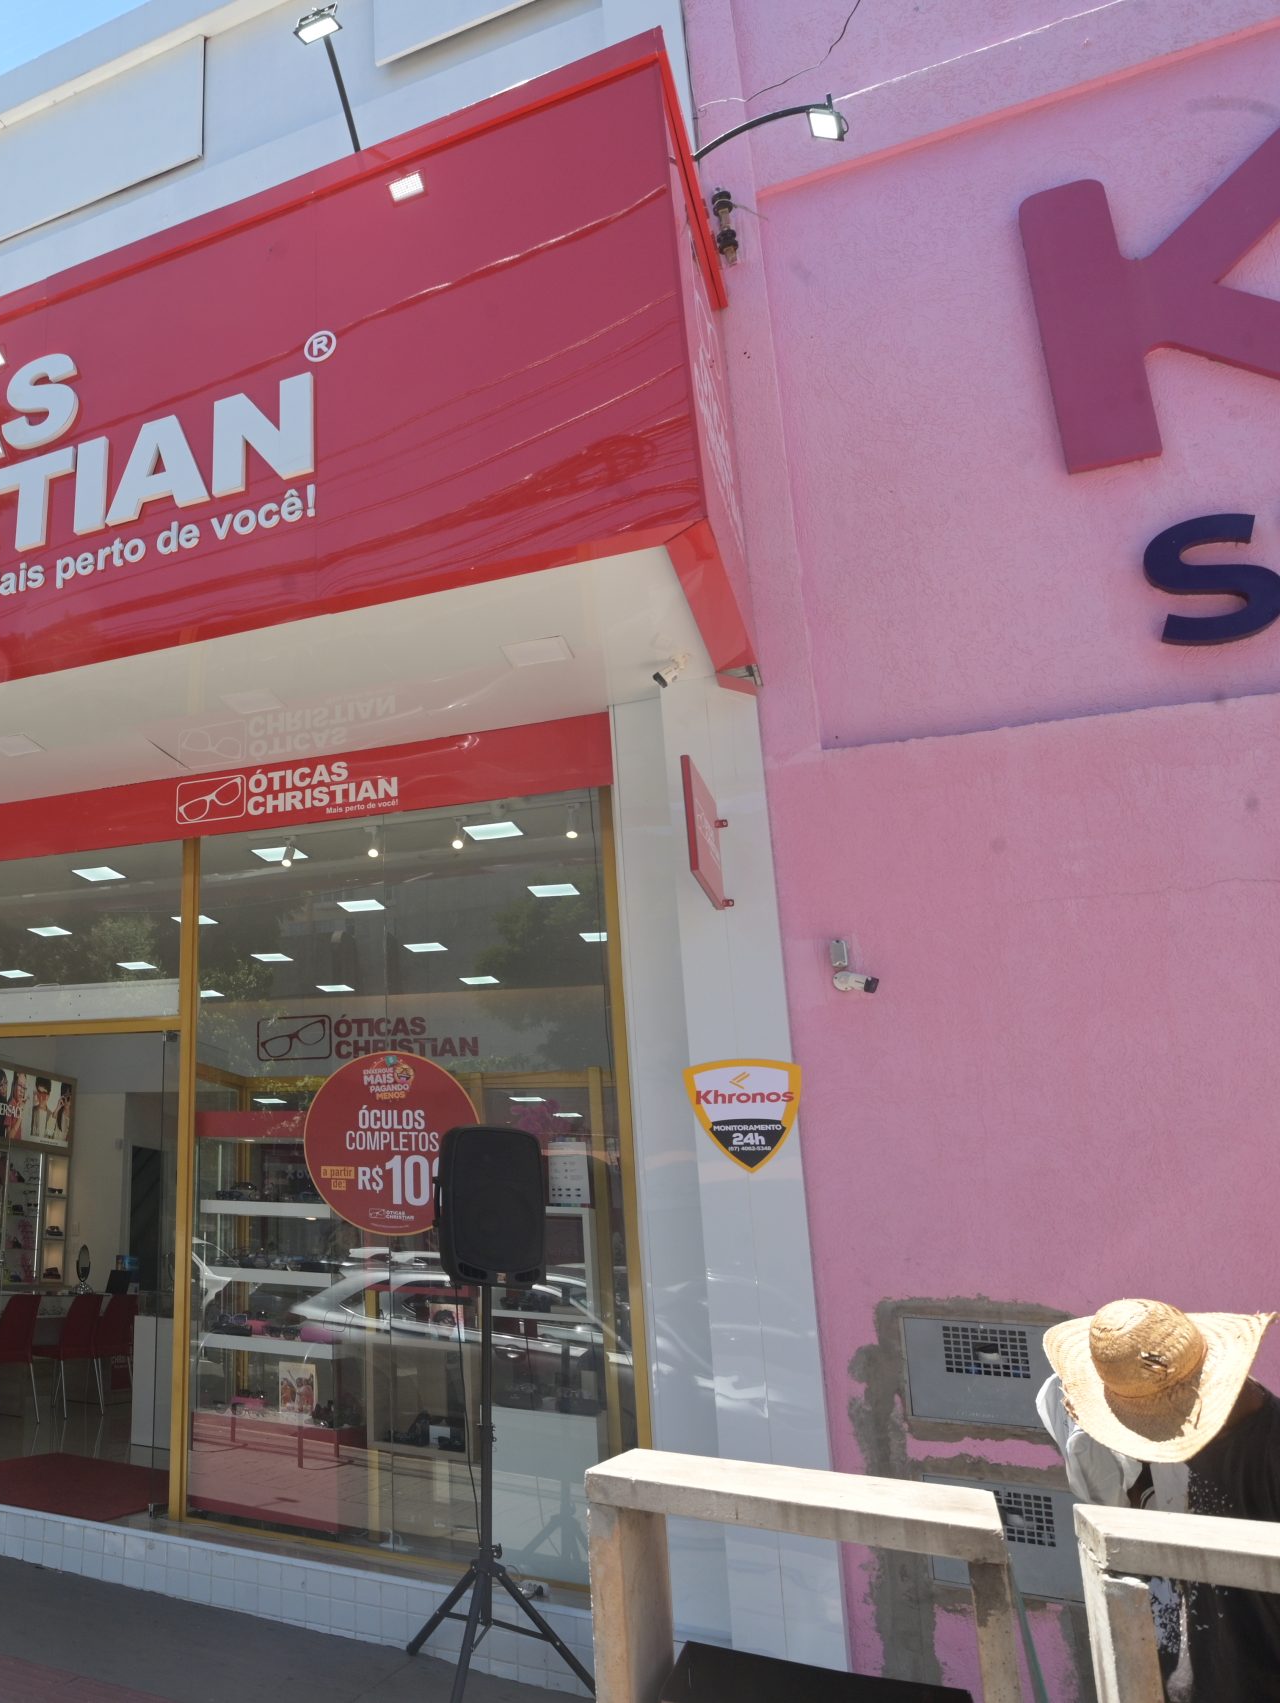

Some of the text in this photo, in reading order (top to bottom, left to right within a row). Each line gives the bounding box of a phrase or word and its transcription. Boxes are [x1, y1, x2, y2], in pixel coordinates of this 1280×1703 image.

[55, 537, 147, 589] perto
[156, 521, 201, 555] de
[210, 483, 316, 541] você!
[248, 761, 349, 794] ÓTICAS
[247, 776, 398, 816] CHRISTIAN
[326, 798, 399, 815] Mais perto de você!
[334, 1014, 427, 1039] ÓTICAS
[334, 1036, 480, 1059] CHRISTIAN
[363, 1074, 394, 1086] MAIS
[369, 1084, 410, 1093] PAGANDO
[376, 1091, 406, 1101] MENOS
[695, 1089, 795, 1105] Khronos
[358, 1105, 426, 1130] ÓCULOS
[713, 1124, 782, 1132] MONITORAMENTO
[346, 1130, 439, 1152] COMPLETOS
[732, 1132, 766, 1146] 24h
[322, 1168, 328, 1177] a
[329, 1166, 353, 1179] partir
[357, 1165, 384, 1194] R$
[333, 1180, 346, 1189] de:
